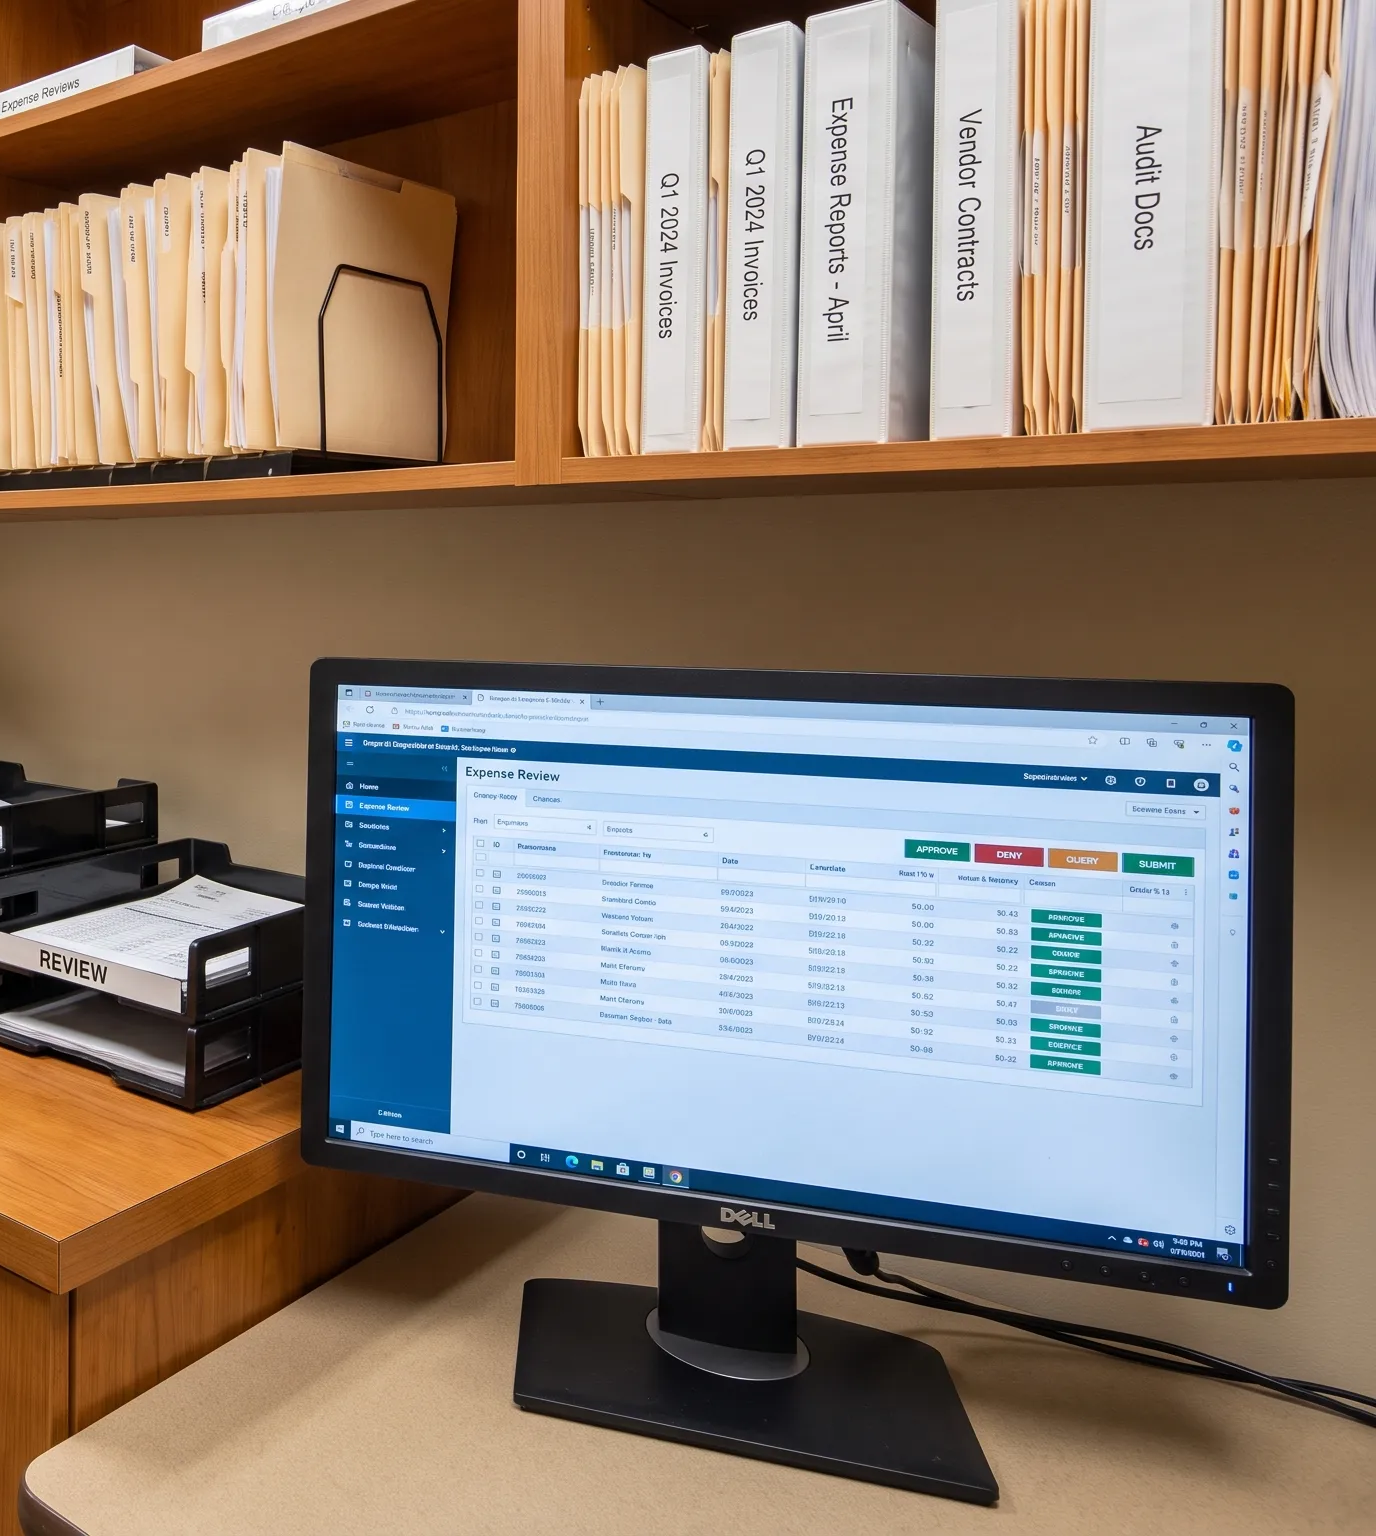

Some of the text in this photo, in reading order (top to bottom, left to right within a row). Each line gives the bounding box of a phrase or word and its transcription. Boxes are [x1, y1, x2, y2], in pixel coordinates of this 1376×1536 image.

[2, 79, 80, 113] Expense Reviews
[824, 97, 853, 187] Expense
[1134, 124, 1162, 250] Audit Docs
[957, 108, 982, 302] Vendor Contracts
[742, 148, 766, 321] Q1 2024 Invoices
[824, 193, 851, 275] Reports
[659, 173, 679, 339] Q1 2024 Invoices
[825, 296, 850, 342] April
[466, 766, 560, 781] Expense Review
[916, 845, 958, 856] APPROVE
[996, 851, 1023, 860] DENY
[1139, 860, 1176, 870] SUBMIT
[39, 949, 108, 984] REVIEW
[386, 1131, 401, 1141] here
[411, 1137, 434, 1145] search
[720, 1207, 776, 1230] DELL
